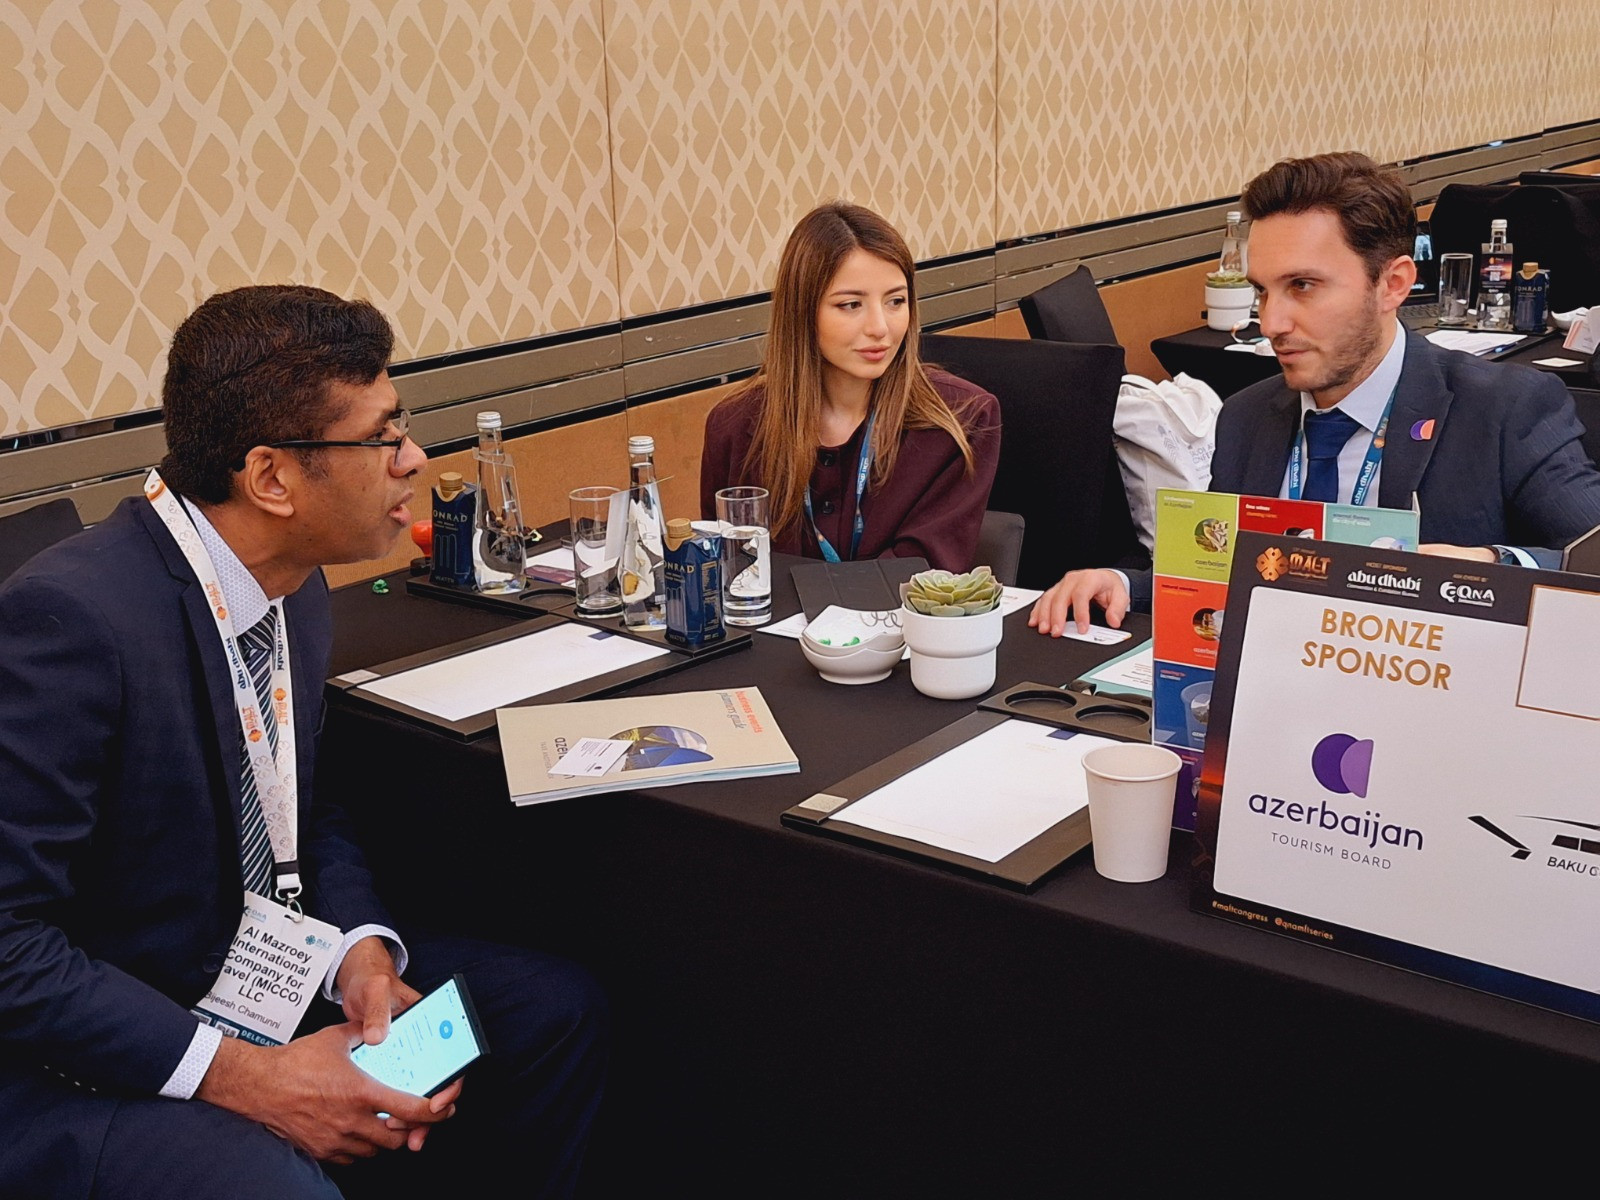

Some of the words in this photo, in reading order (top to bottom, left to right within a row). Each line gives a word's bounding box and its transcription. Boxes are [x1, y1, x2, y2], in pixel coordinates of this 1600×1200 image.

[432, 509, 468, 523] ONRAD
[1347, 570, 1376, 585] abu
[1377, 573, 1422, 592] dhabi
[1321, 608, 1444, 652] BRONZE
[226, 637, 241, 669] dhabi
[1301, 641, 1452, 691] SPONSOR
[237, 669, 246, 690] abu
[1248, 793, 1424, 851] azerbaijan
[1271, 831, 1334, 856] TOURISM
[1340, 849, 1392, 870] BOARD
[1546, 856, 1588, 874] BAKU
[233, 935, 311, 978] International
[243, 925, 260, 940] Al
[260, 932, 313, 965] Mazroey
[226, 948, 284, 983] Company
[285, 974, 304, 990] for
[238, 984, 265, 1003] LLC
[251, 975, 303, 1007] (MICCO)
[237, 1004, 281, 1030] Chamunni
